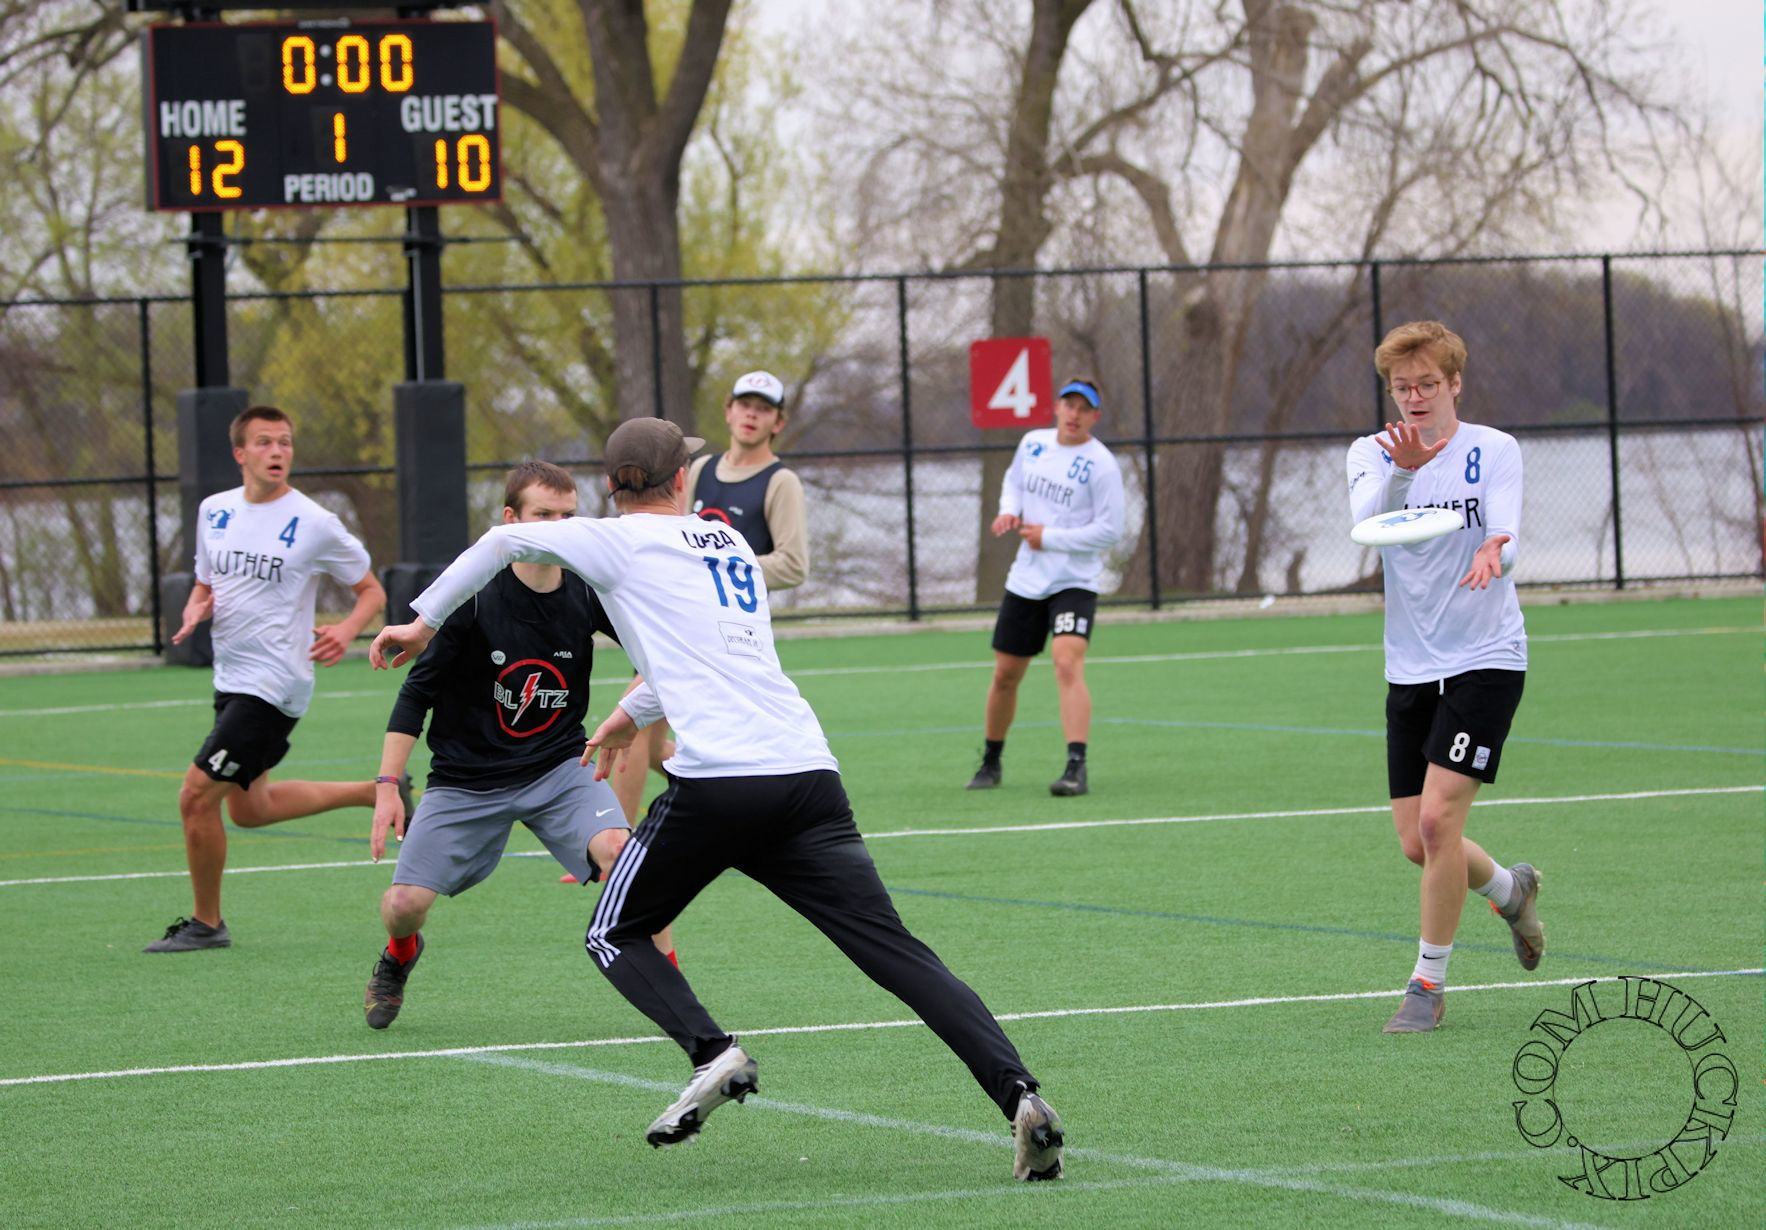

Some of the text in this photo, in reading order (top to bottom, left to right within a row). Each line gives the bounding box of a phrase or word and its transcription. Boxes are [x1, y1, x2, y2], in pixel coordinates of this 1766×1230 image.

[282, 34, 414, 94] 0:00
[160, 100, 247, 138] HOME
[401, 94, 499, 132] GUEST
[333, 112, 347, 164] 1
[189, 140, 246, 198] 12
[435, 134, 492, 192] 10
[284, 173, 375, 202] PERIOD
[987, 346, 1038, 419] 4
[1067, 456, 1095, 485] 55
[1465, 446, 1482, 485] 8
[1025, 473, 1075, 509] UTHER
[278, 516, 300, 549] 4
[209, 551, 284, 583] UTHER
[703, 556, 758, 613] 19
[1054, 611, 1076, 634] 55
[208, 749, 228, 772] 4
[1448, 732, 1471, 763] 8
